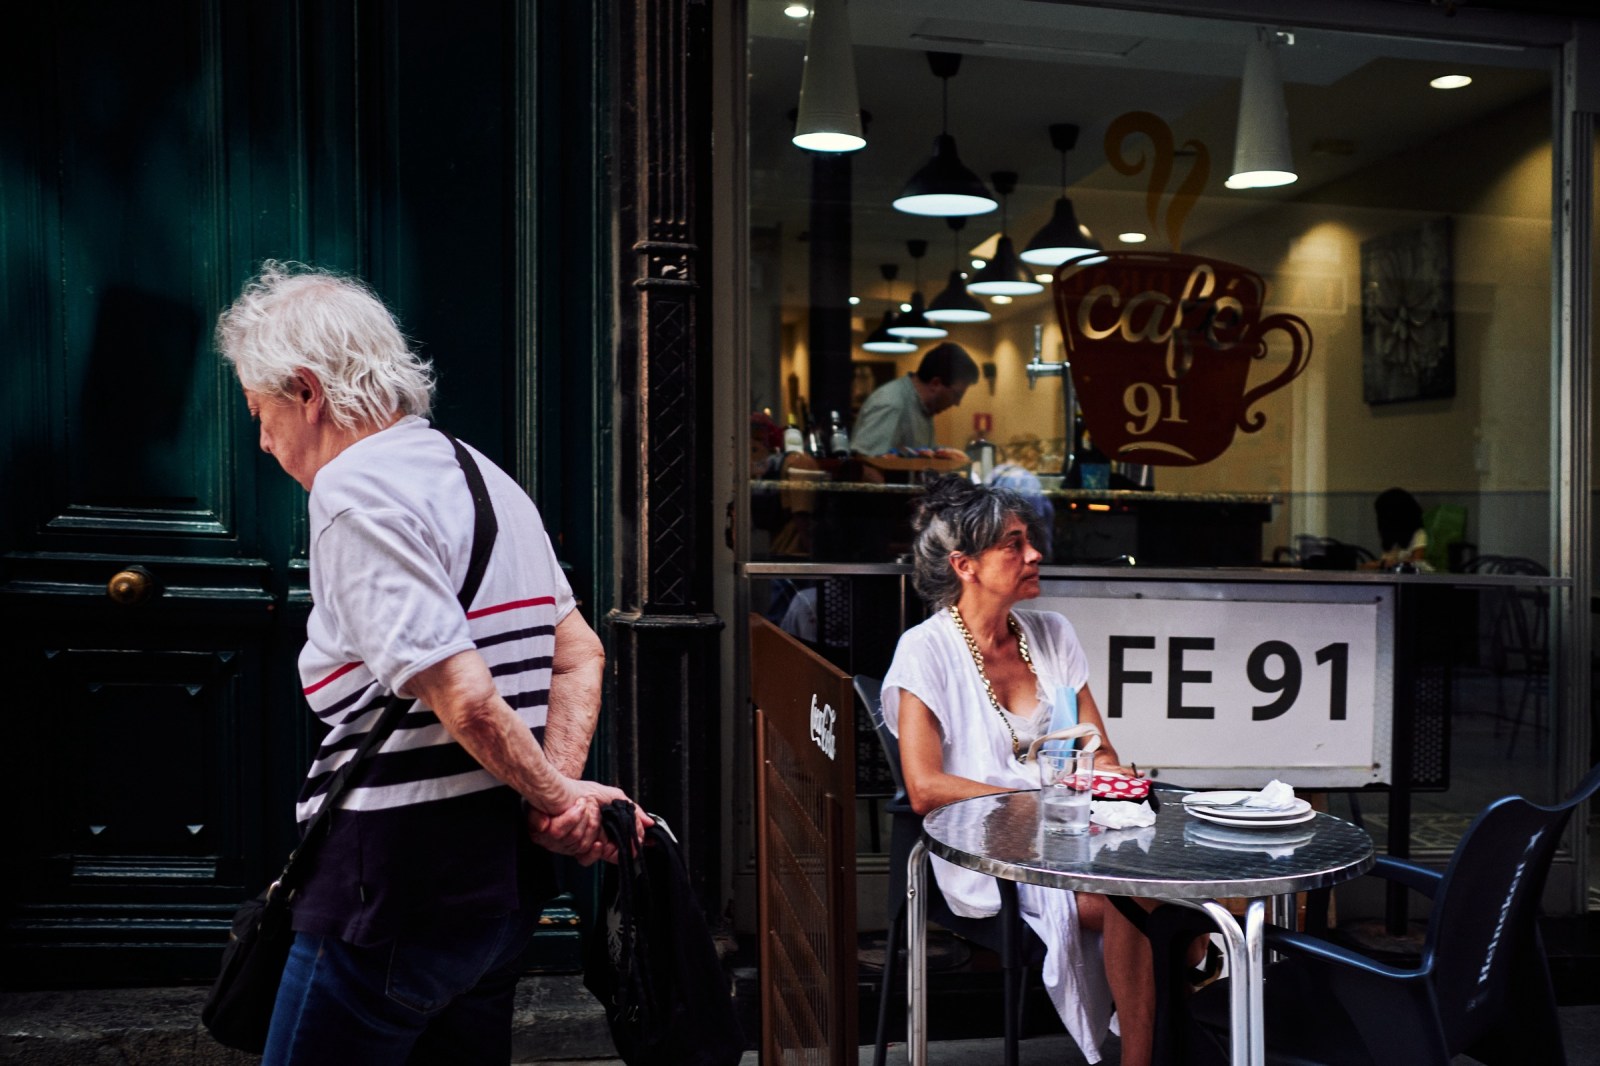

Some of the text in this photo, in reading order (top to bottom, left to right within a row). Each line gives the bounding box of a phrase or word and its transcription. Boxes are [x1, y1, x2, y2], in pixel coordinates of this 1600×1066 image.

[1078, 264, 1249, 379] café
[1123, 382, 1188, 435] 91
[1246, 640, 1349, 721] 91
